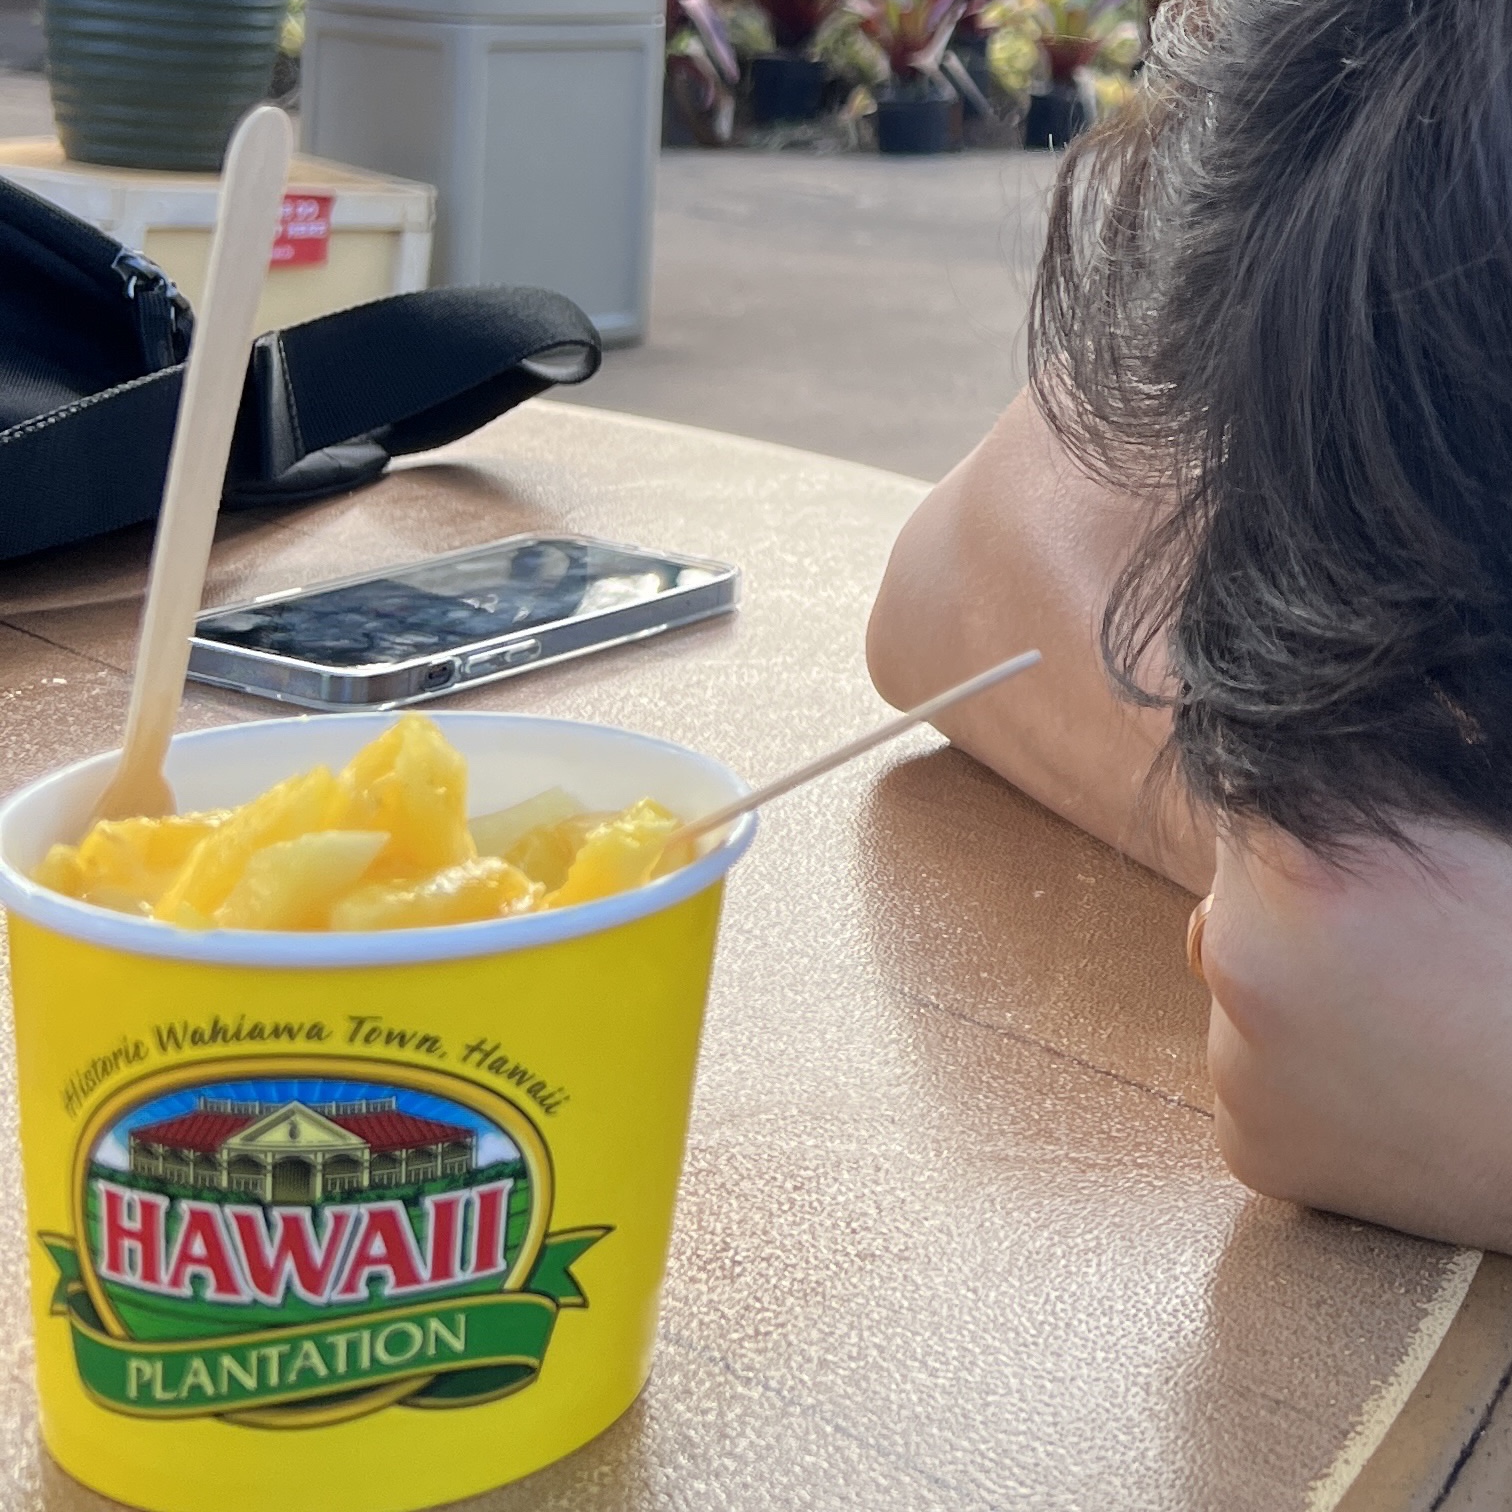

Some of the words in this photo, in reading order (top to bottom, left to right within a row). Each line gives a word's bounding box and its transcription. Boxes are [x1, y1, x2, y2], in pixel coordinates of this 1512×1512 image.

[62, 1036, 149, 1120] Historic
[154, 1014, 332, 1052] Wahiawa
[347, 1014, 448, 1059] Town,
[460, 1038, 570, 1116] Hawaii
[98, 1179, 514, 1306] HAWAII
[125, 1312, 467, 1400] PLANTATION
